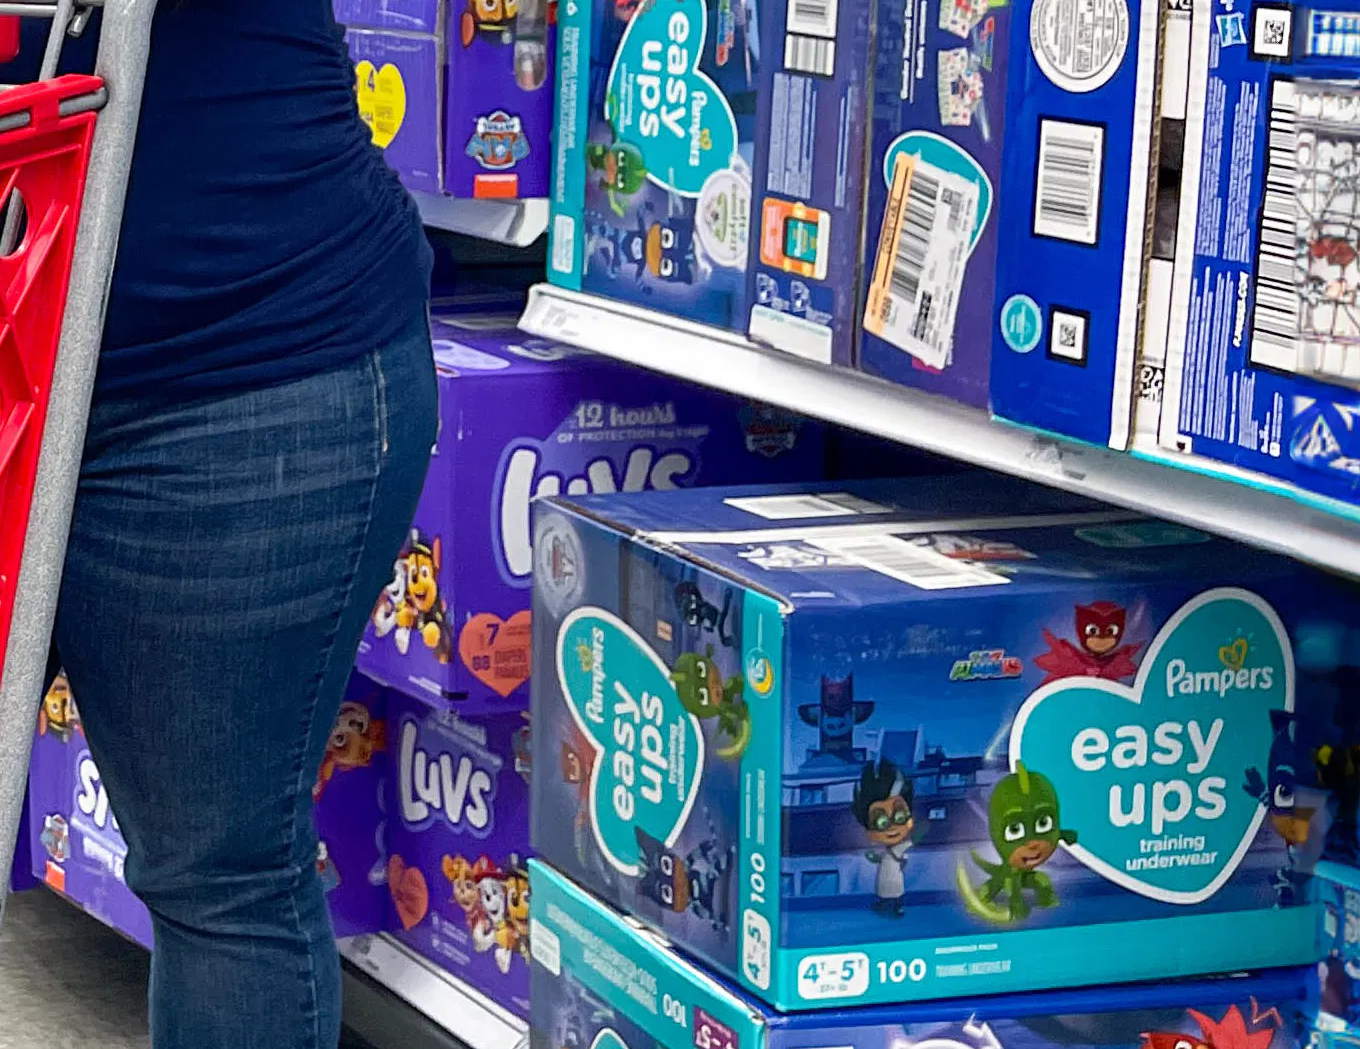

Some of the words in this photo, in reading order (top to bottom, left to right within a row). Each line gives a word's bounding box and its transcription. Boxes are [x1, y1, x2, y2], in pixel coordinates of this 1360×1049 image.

[639, 39, 662, 139] ups
[666, 11, 690, 139] easy
[610, 403, 677, 428] hours
[589, 625, 605, 724] Pampers
[1166, 657, 1273, 699] Pampers
[612, 680, 641, 822] easy
[638, 691, 664, 805] ups
[1071, 716, 1223, 774] easy
[1108, 773, 1227, 835] ups
[1125, 851, 1218, 871] underwear
[1139, 834, 1205, 853] training
[750, 852, 767, 904] 100
[877, 958, 927, 985] 100
